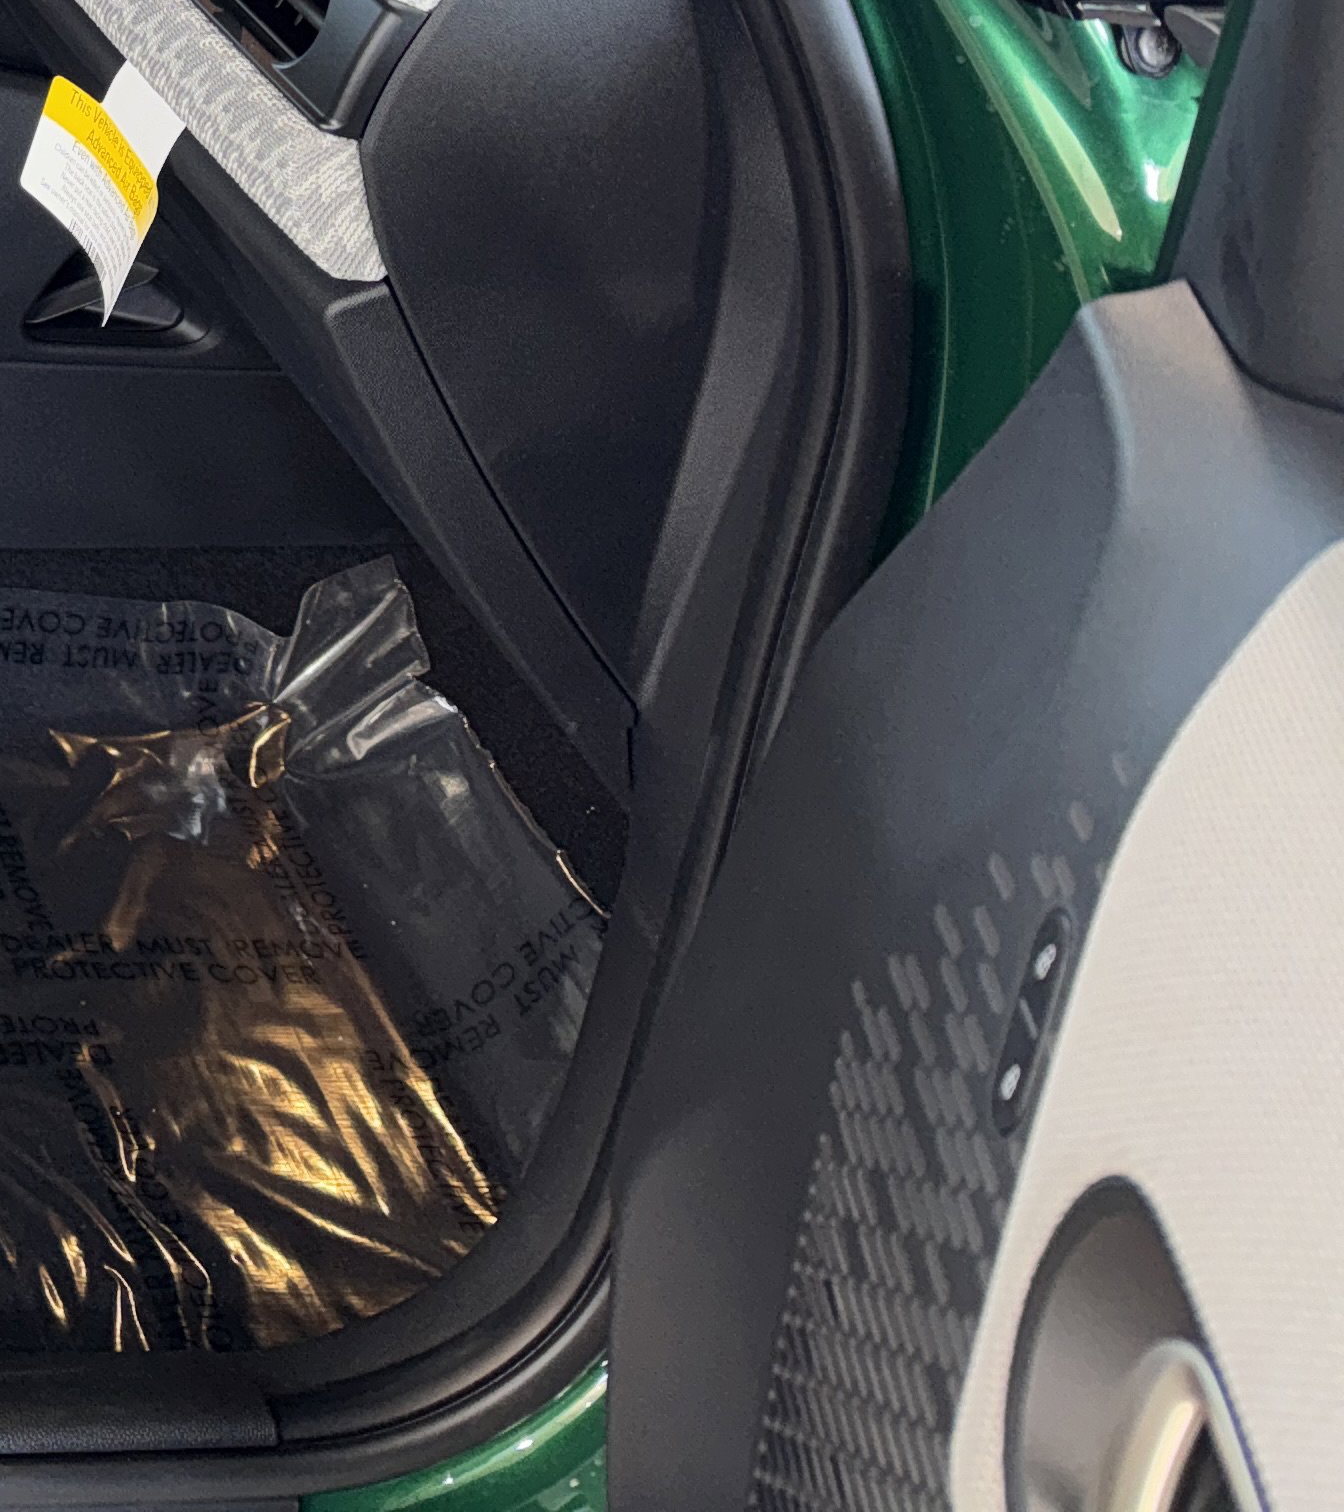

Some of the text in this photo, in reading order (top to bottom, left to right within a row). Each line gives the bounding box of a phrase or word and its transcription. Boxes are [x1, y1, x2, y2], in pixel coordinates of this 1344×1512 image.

[70, 90, 91, 117] This
[93, 107, 119, 146] Vehicle
[86, 130, 122, 175] Advanced
[63, 644, 137, 669] MUST
[0, 933, 115, 955] DEALER
[136, 936, 214, 956] MUST
[12, 956, 322, 986] PROTECTIVE COVER
[514, 944, 581, 1017] MUST
